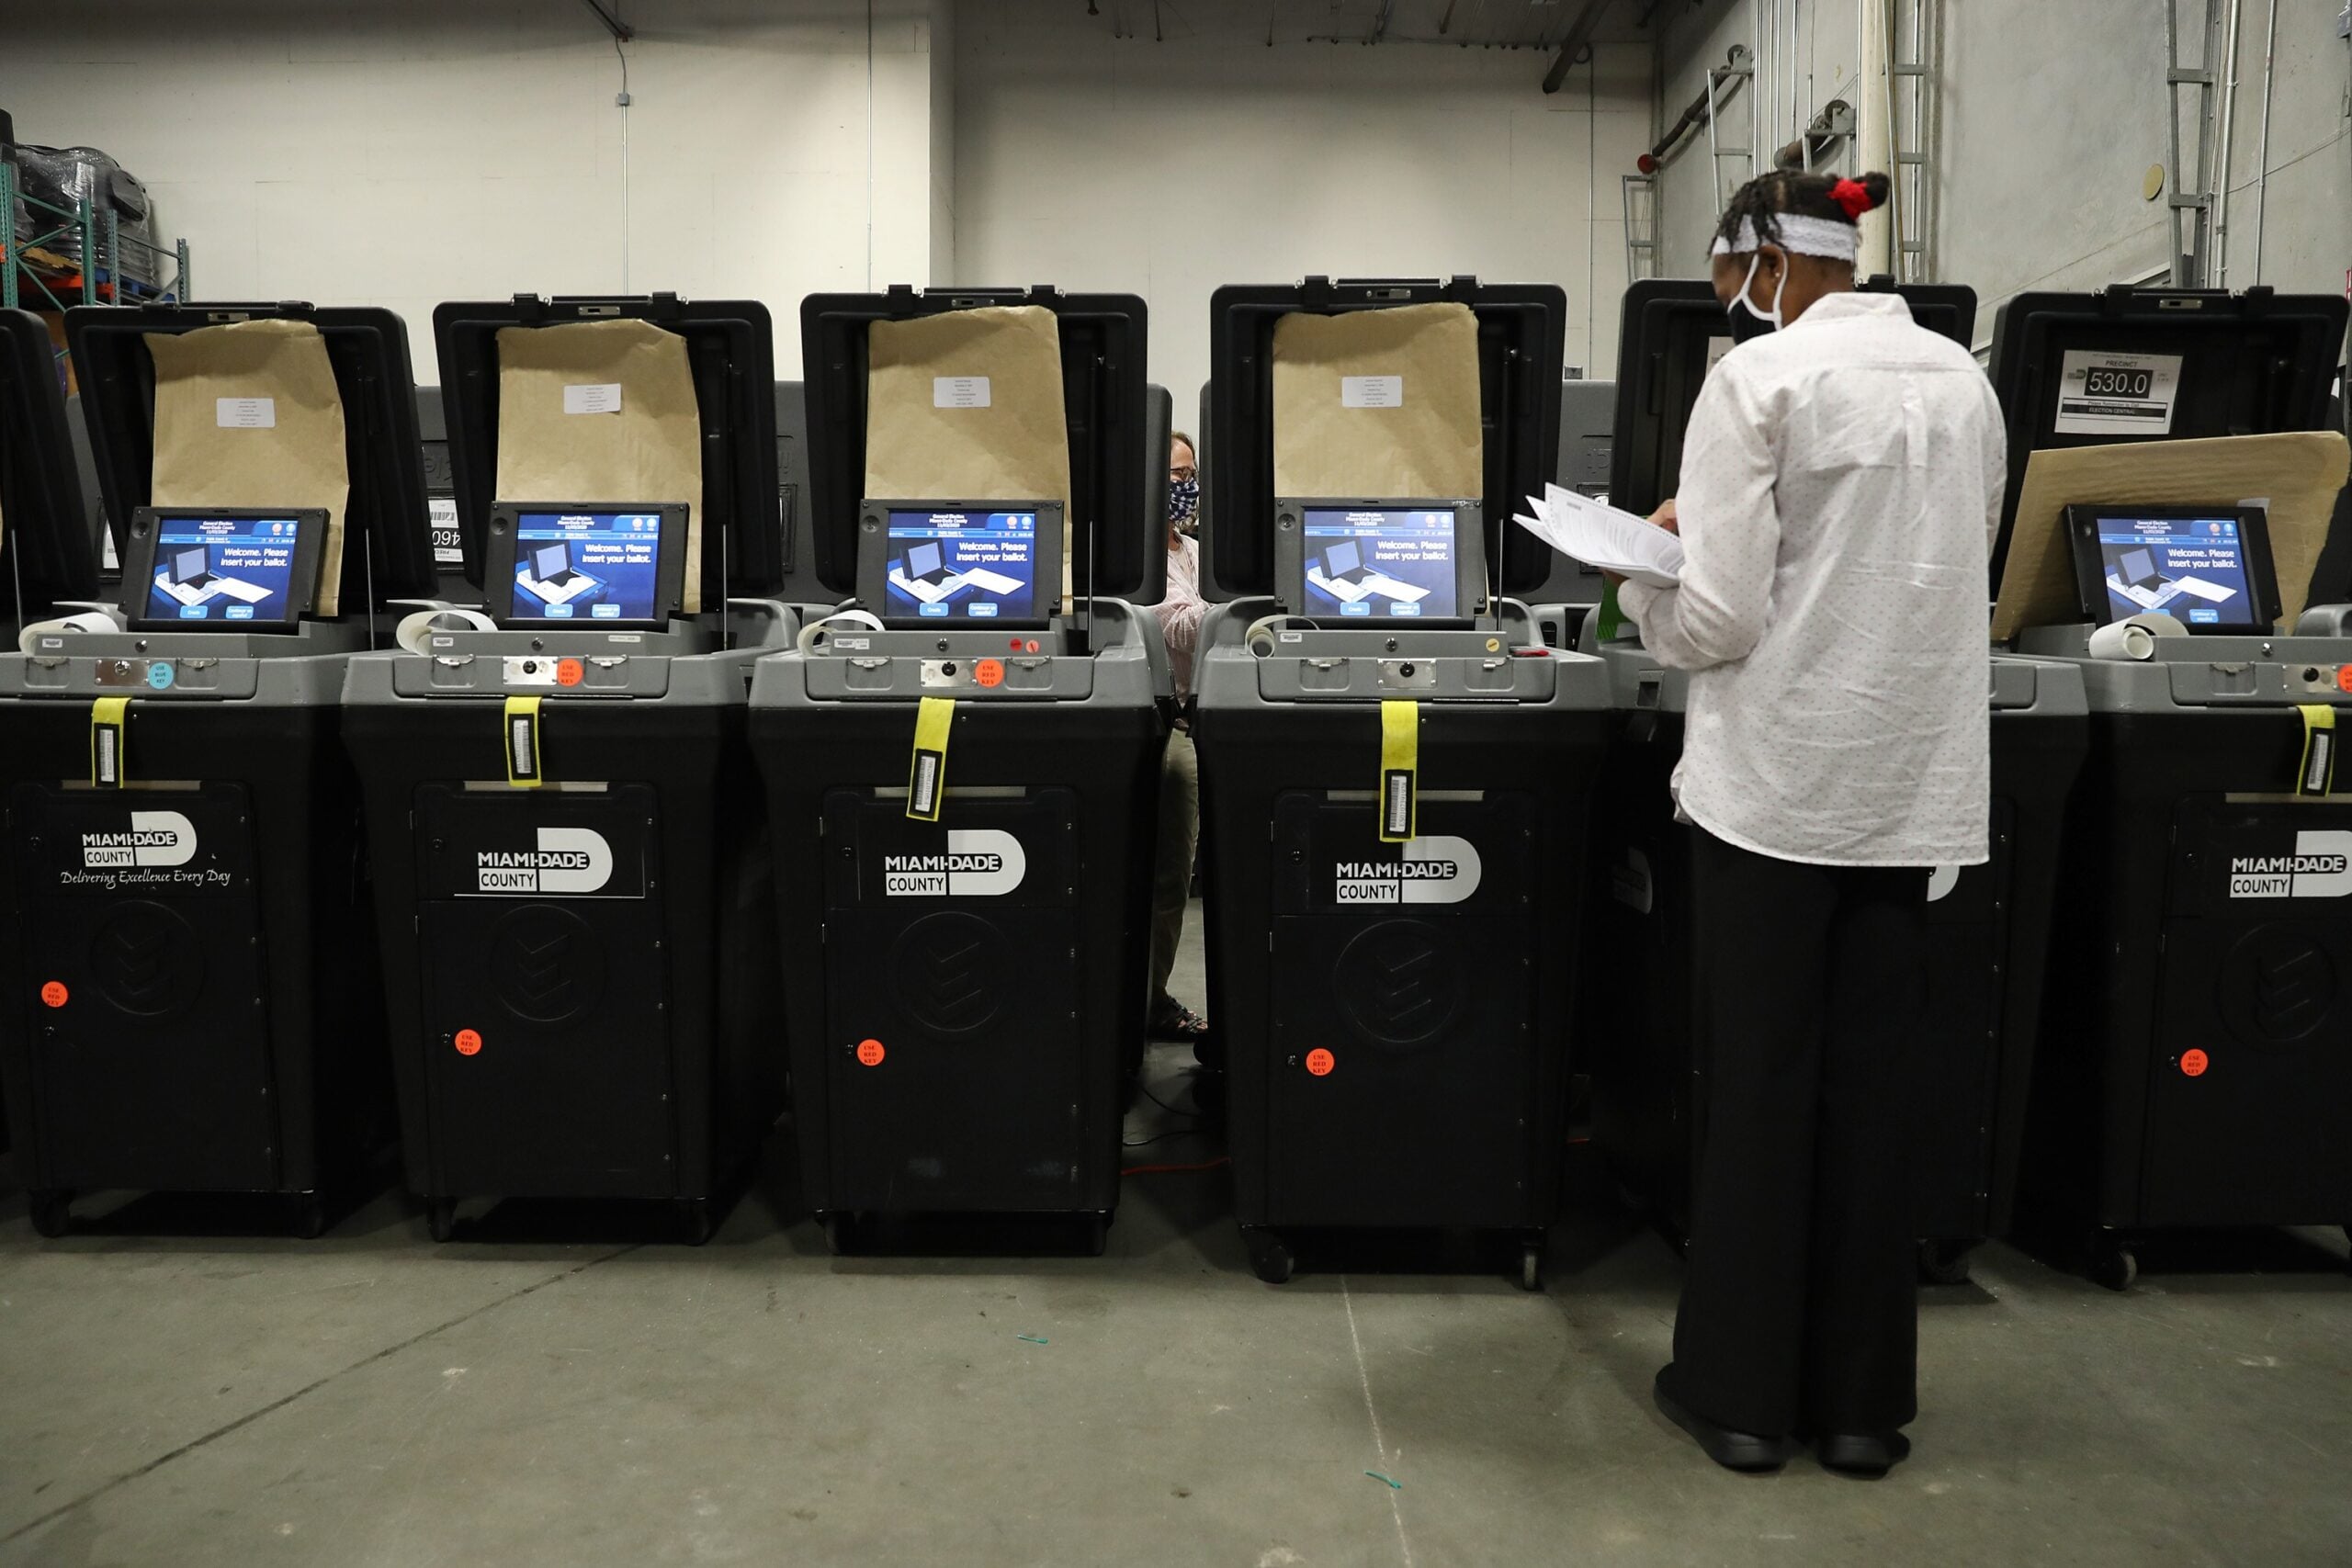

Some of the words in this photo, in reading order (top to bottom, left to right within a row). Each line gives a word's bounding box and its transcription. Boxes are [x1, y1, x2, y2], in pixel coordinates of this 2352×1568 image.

[2105, 360, 2138, 368] PRECINCT
[2089, 372, 2147, 394] 530.0
[585, 544, 624, 553] Welcome.
[626, 544, 651, 553] Please
[958, 542, 998, 551] Welcome.
[1001, 542, 1027, 551] Please
[1377, 541, 1418, 549] Welcome.
[1420, 541, 1447, 549] Please
[224, 548, 261, 557] Welcome.
[264, 548, 288, 557] Please
[981, 555, 1001, 563] your
[1002, 553, 1027, 561] ballot.
[1401, 553, 1420, 561] your
[1422, 551, 1448, 559] ballot.
[2167, 549, 2207, 558] Welcome.
[2209, 549, 2234, 558] Please
[244, 559, 263, 568] your
[606, 556, 626, 564] your
[2192, 561, 2211, 570] your
[82, 832, 175, 847] MIAMI-DADE
[86, 851, 132, 863] COUNTY
[478, 852, 588, 868] MIAMI-DADE
[885, 856, 1000, 871] MIAMI-DADE
[2231, 856, 2345, 873] MIAMI-DADE
[1336, 863, 1454, 878] MIAMI-DADE
[61, 870, 116, 889] Delivering
[119, 869, 171, 885] Excellence
[174, 870, 204, 886] Every
[206, 869, 231, 886] Day
[481, 873, 535, 887] COUNTY
[888, 877, 944, 891] COUNTY
[1339, 885, 1396, 899] COUNTY
[2233, 879, 2288, 894] COUNTY
